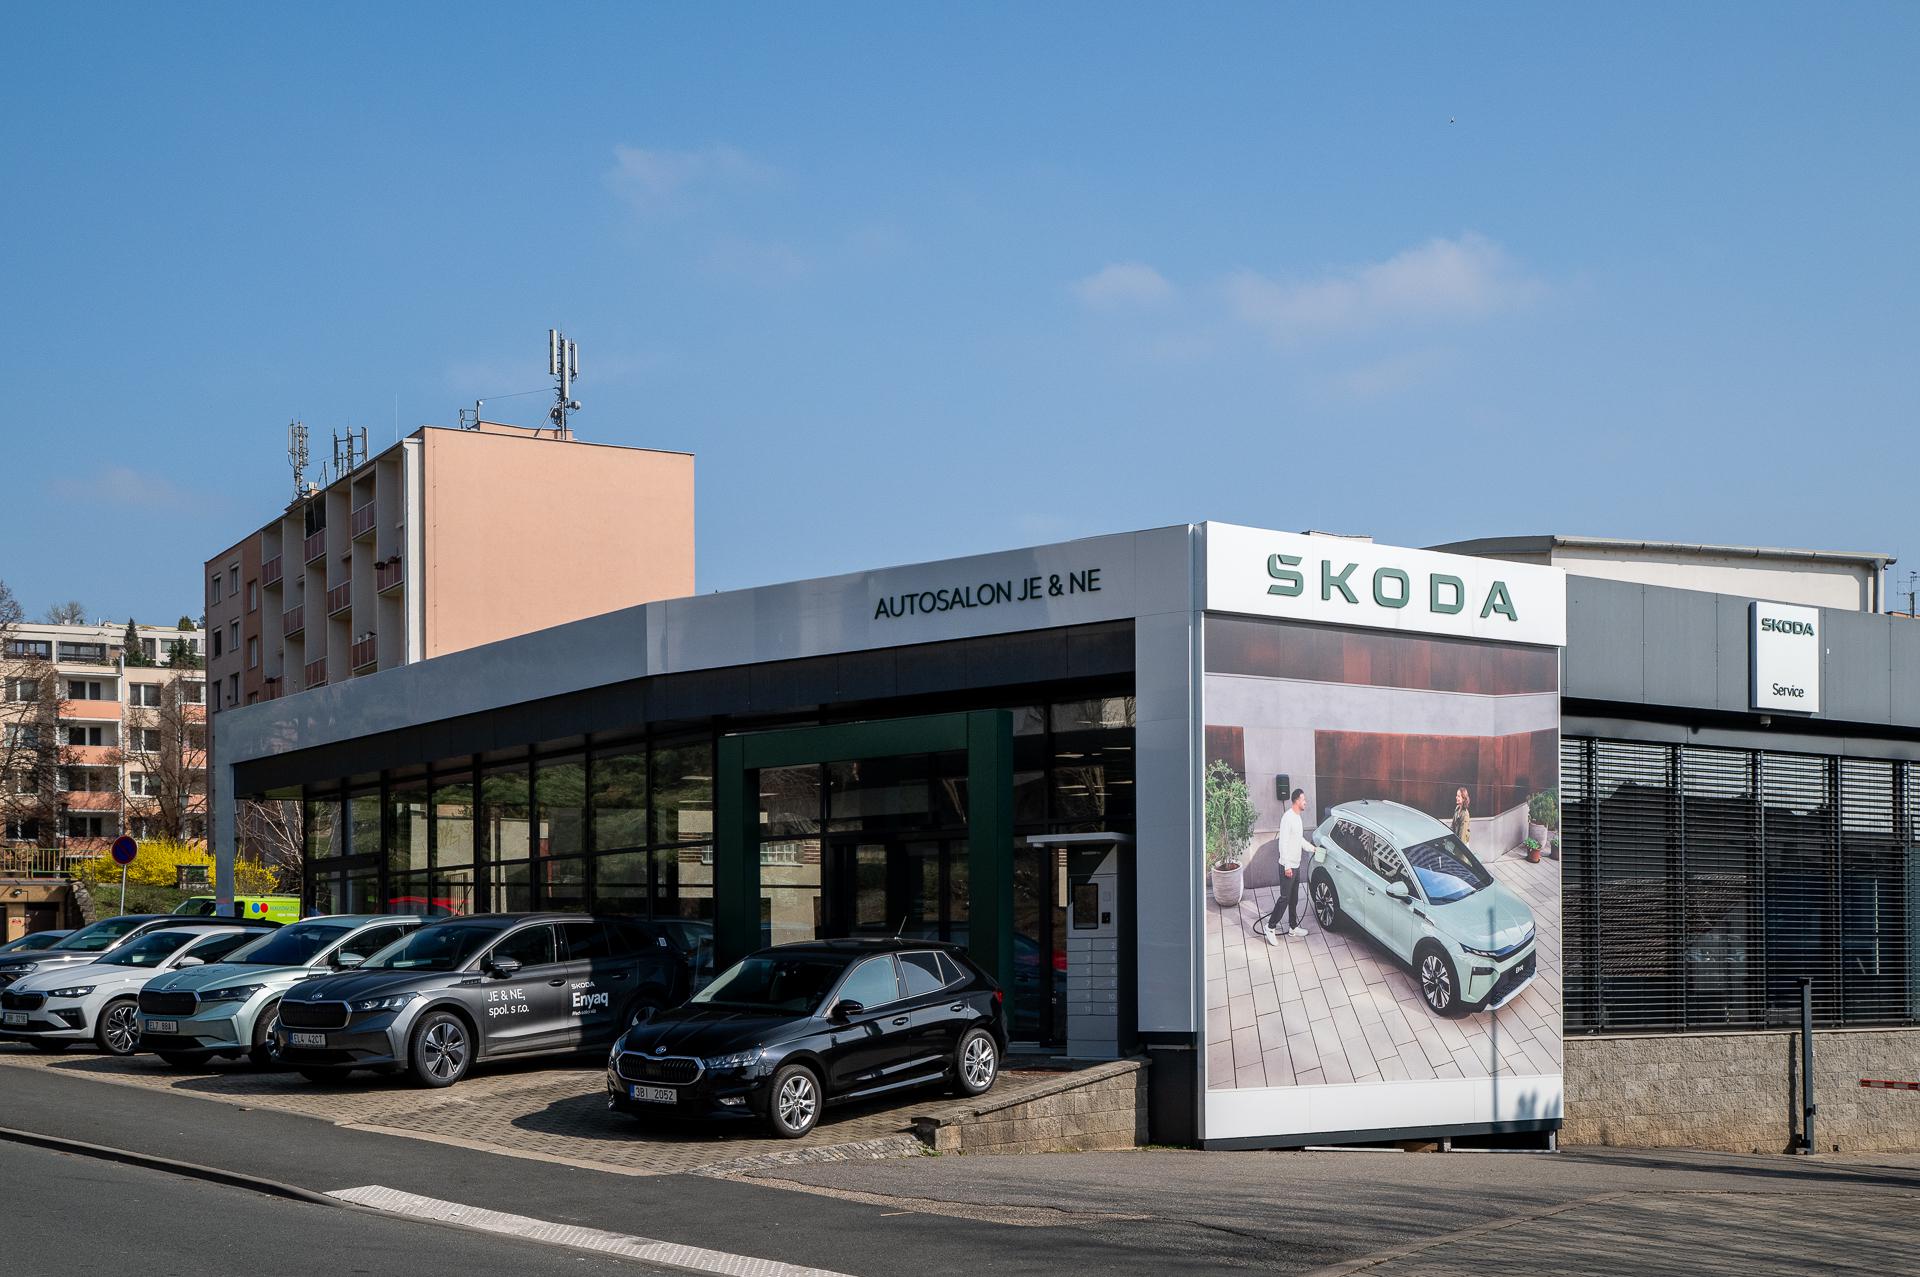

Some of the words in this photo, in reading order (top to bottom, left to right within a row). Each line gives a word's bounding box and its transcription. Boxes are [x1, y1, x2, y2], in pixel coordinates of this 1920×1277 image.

[874, 581, 1012, 620] AUTOSALON
[1017, 576, 1043, 601] JE
[1048, 573, 1065, 597] &
[1069, 568, 1102, 594] NE
[1772, 682, 1805, 698] Service
[488, 990, 499, 1002] JE
[501, 991, 509, 1001] &
[510, 988, 526, 1001] NE,
[572, 992, 609, 1009] Enyaq
[489, 1004, 509, 1018] spol.
[510, 1006, 517, 1014] s
[517, 1004, 530, 1014] r.o.
[655, 1088, 674, 1101] 2052
